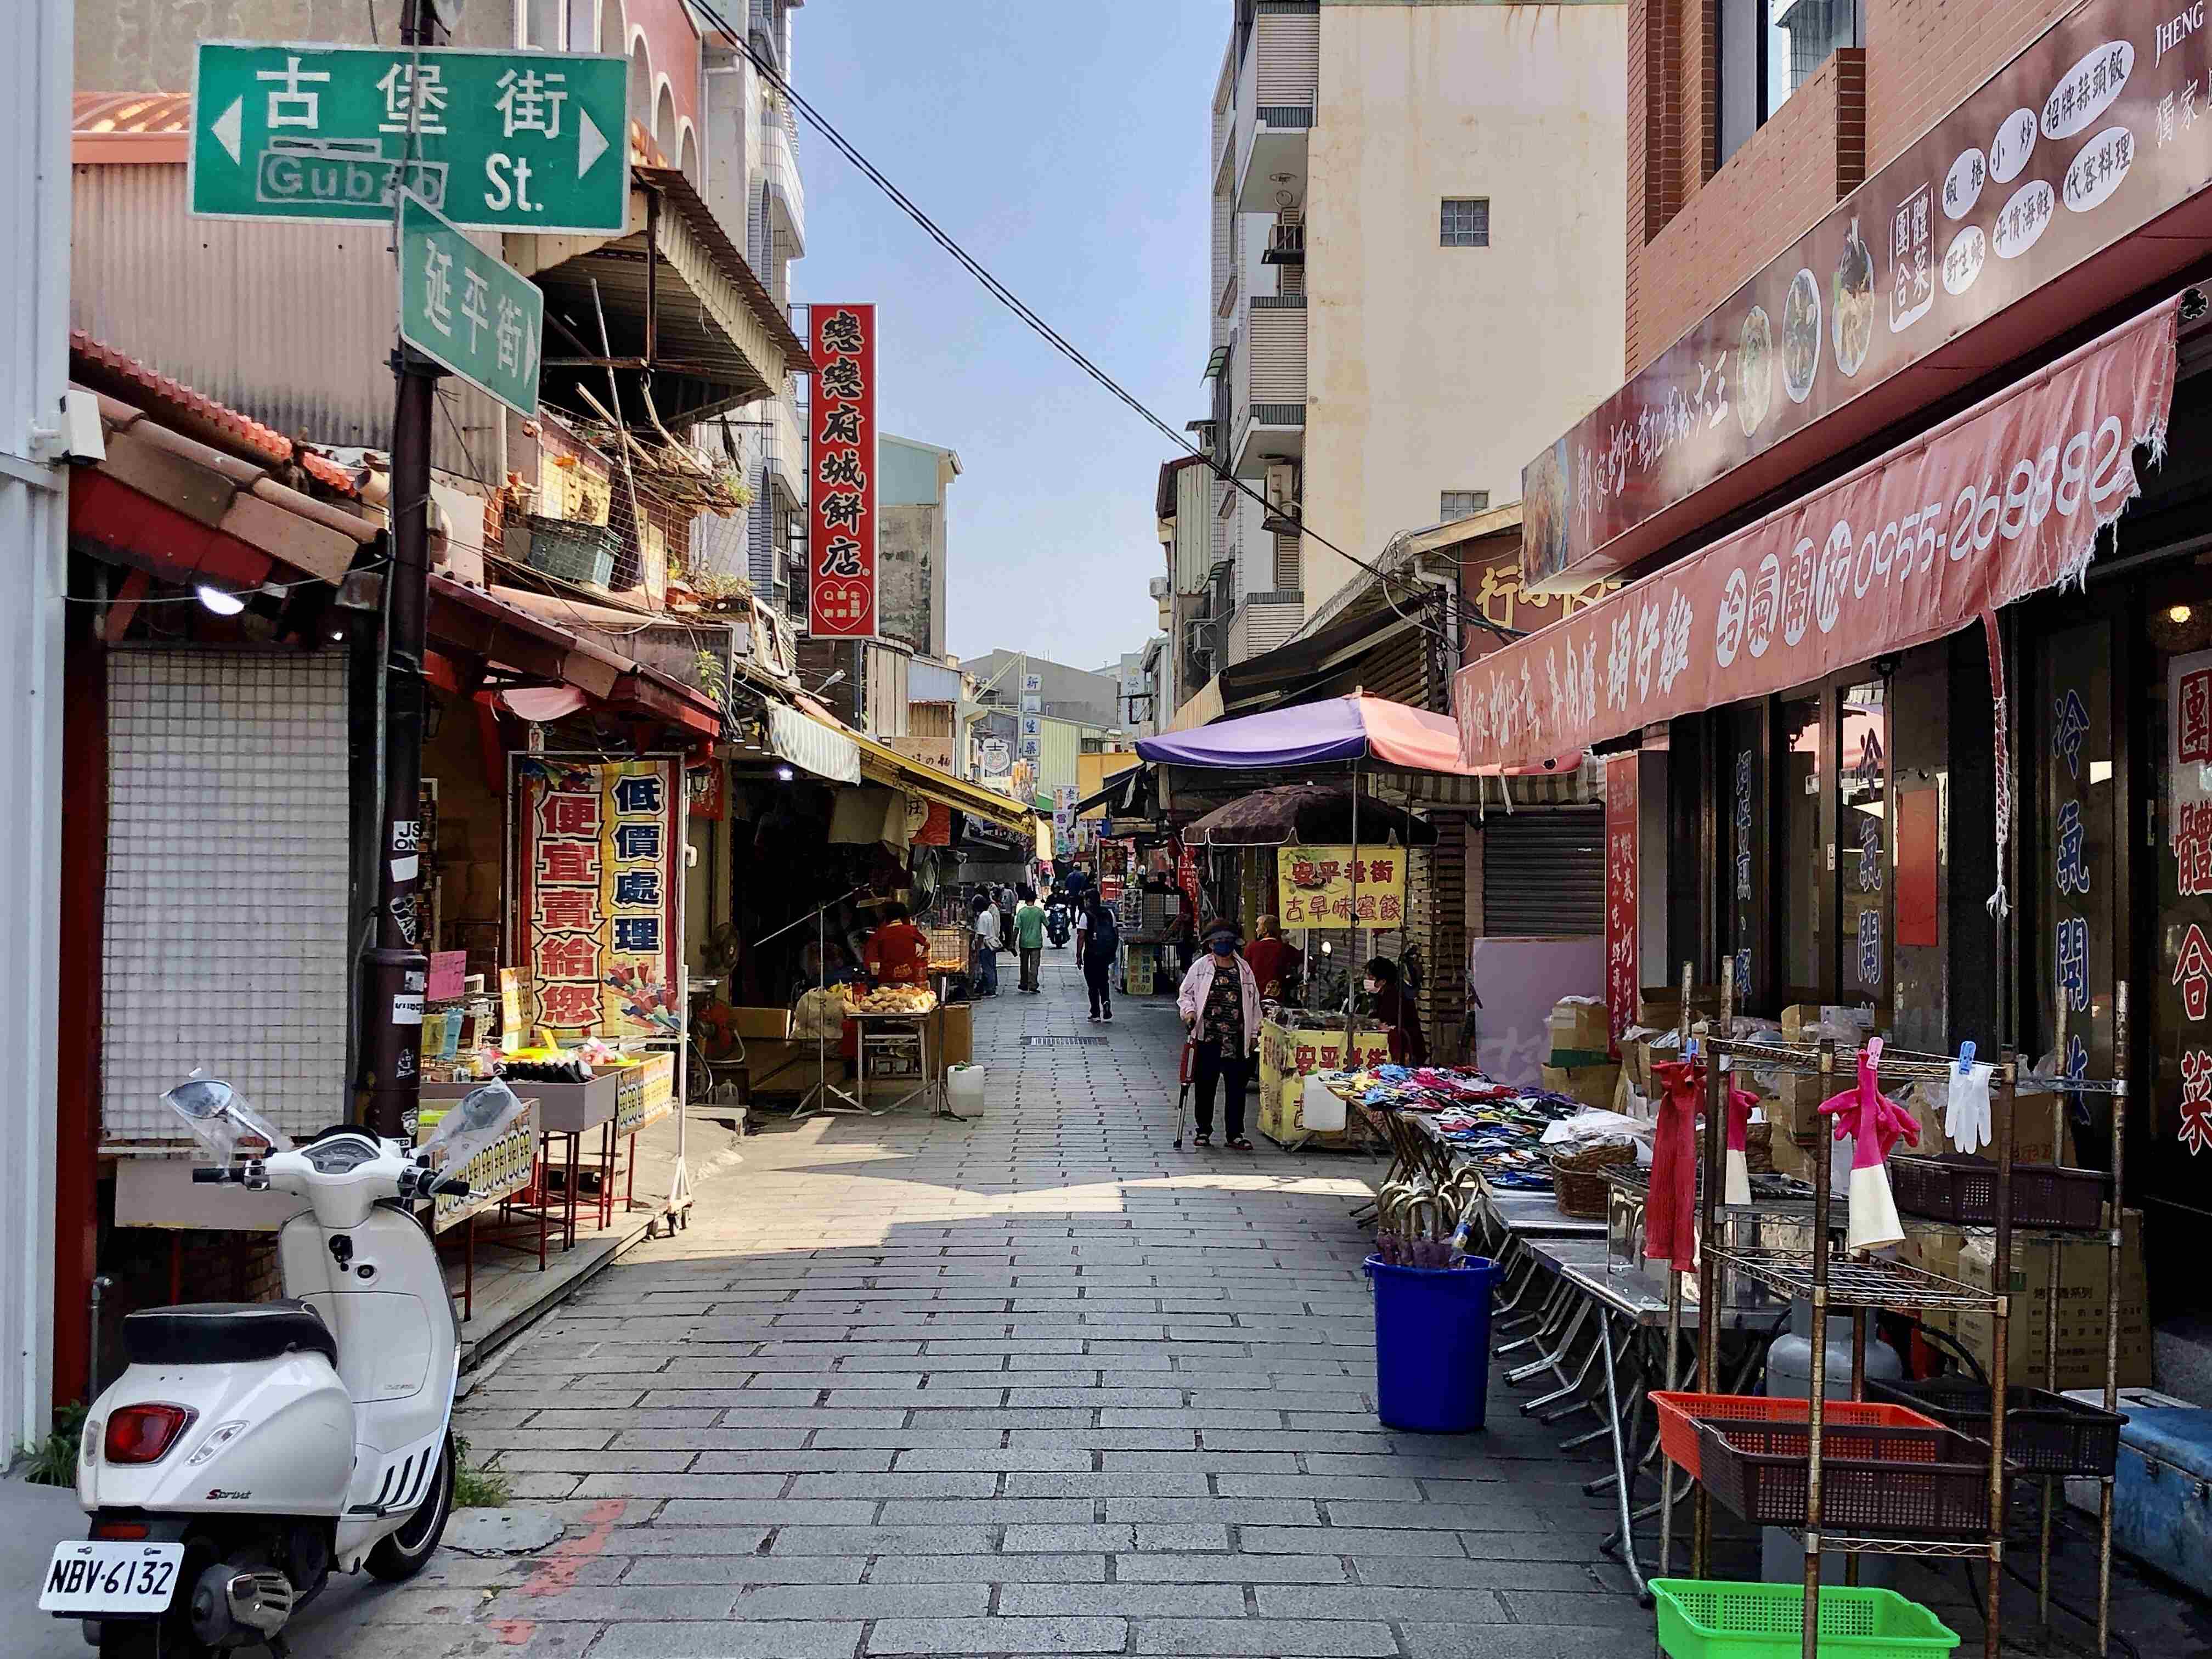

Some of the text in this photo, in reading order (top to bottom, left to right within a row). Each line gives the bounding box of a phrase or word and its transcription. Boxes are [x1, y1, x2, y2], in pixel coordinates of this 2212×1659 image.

[2155, 3, 2204, 69] JHENG
[256, 57, 568, 139] 古堡街
[2045, 47, 2125, 133] 招牌蒜頭飯
[1992, 116, 2034, 172] 小炒
[2066, 132, 2132, 203] 代客料理
[484, 153, 544, 212] St.
[1995, 185, 2052, 251] 平價海鮮
[423, 238, 523, 378] 延平街
[1717, 520, 1853, 668] 冷氣開放
[1853, 415, 2122, 600] 0955-268882
[615, 776, 664, 953] 低價處理
[1292, 860, 1394, 884] 安平老街
[538, 793, 601, 1026] 便宜賣給您
[1285, 894, 1401, 922] 古早味蜜餞
[206, 1488, 252, 1500] Sprint
